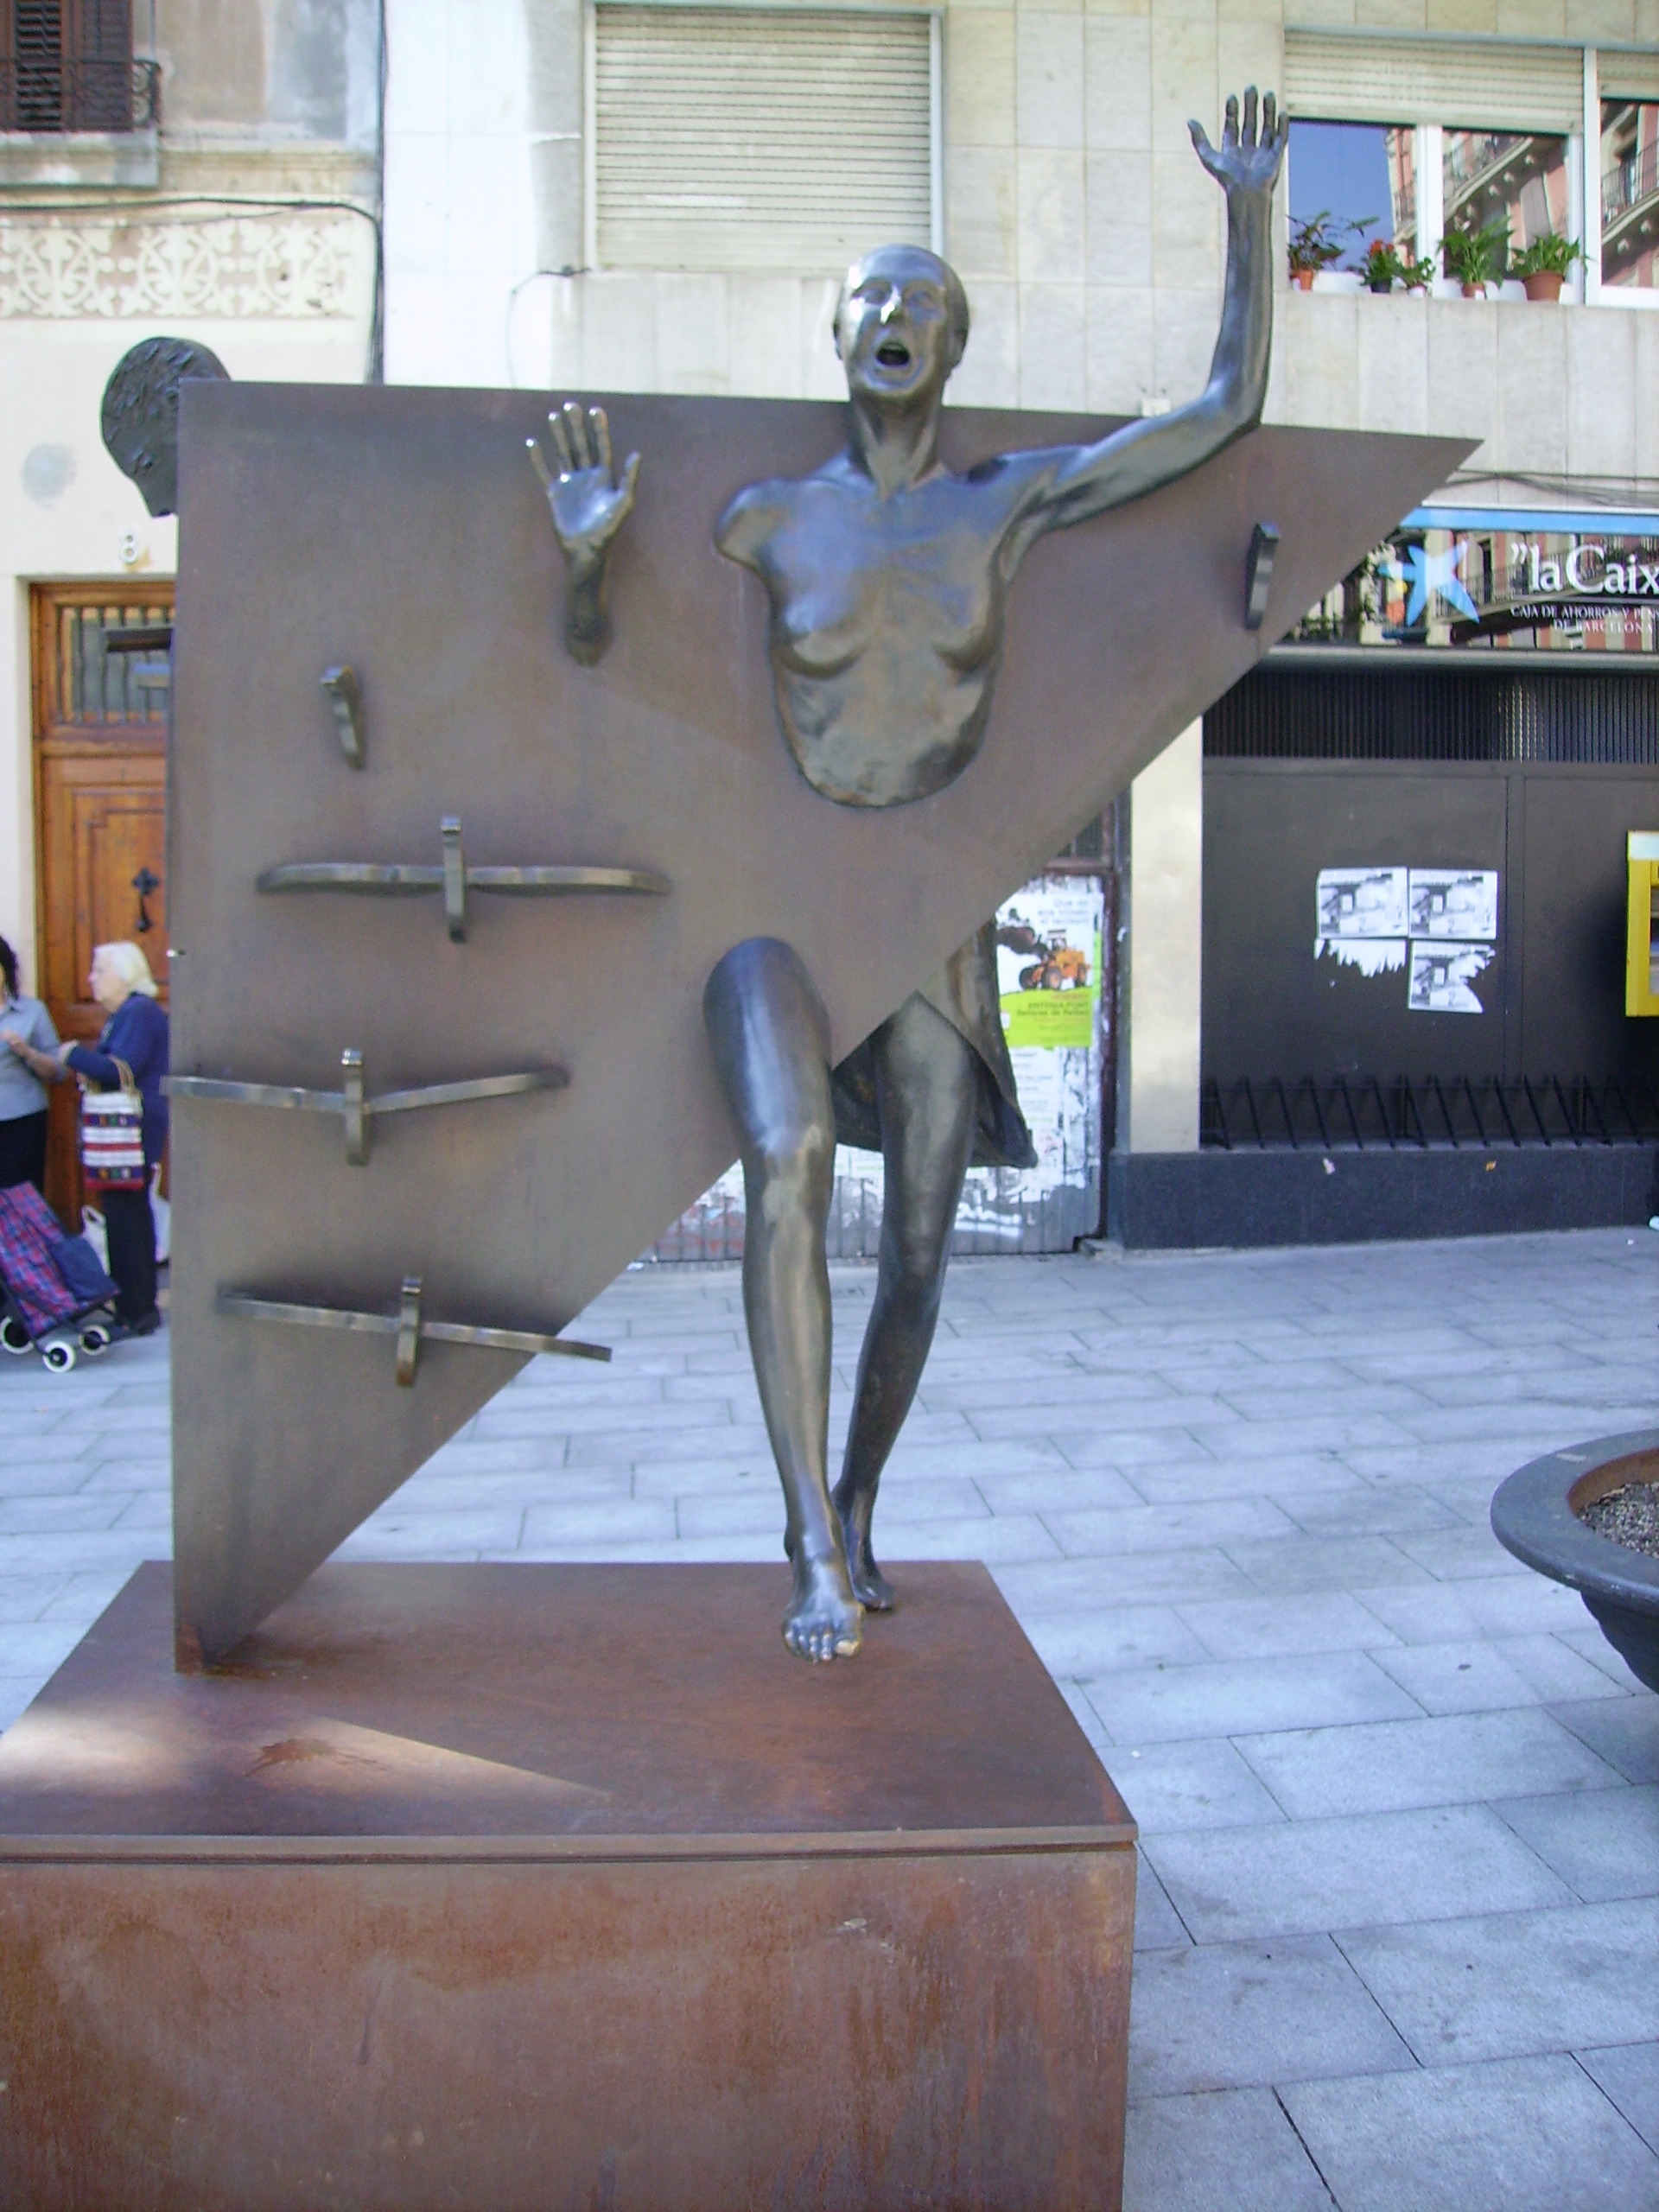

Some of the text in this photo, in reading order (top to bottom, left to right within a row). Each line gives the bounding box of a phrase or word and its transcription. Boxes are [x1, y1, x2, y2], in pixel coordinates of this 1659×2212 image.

[121, 532, 137, 563] 8
[1510, 605, 1538, 618] CAJA
[1541, 605, 1557, 618] DE
[1561, 606, 1618, 620] AHORROS
[1623, 607, 1630, 620] Y
[1554, 619, 1653, 634] DE BARCELONA
